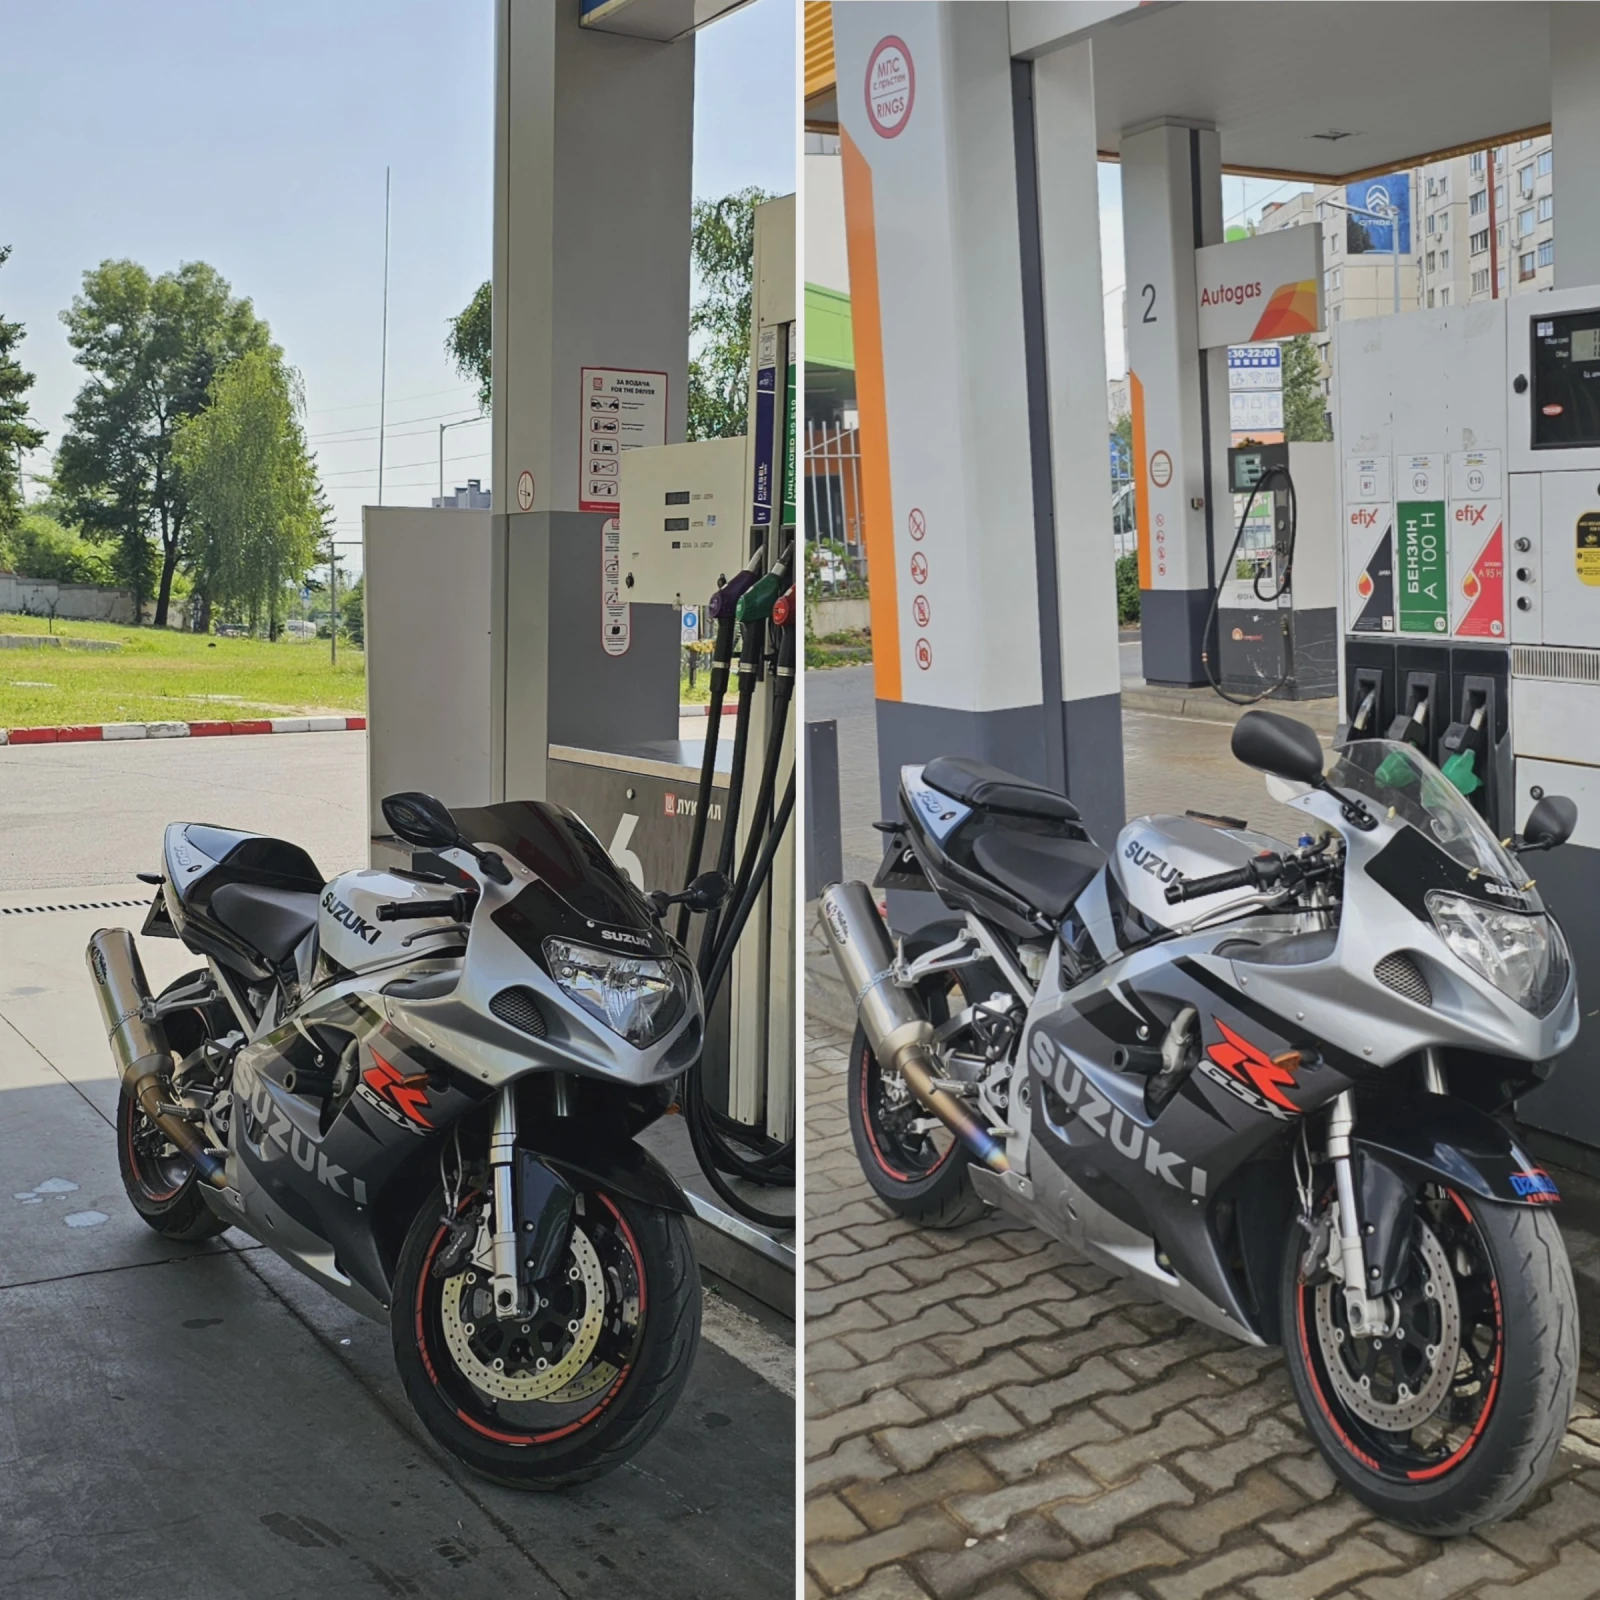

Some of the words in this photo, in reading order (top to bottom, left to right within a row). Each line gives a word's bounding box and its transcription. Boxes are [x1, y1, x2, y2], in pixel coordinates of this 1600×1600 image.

[877, 57, 900, 79] МПС
[877, 96, 905, 119] RINGS
[1142, 283, 1157, 323] 2
[1200, 281, 1262, 307] Autogas
[1228, 348, 1277, 358] :30-22:00
[625, 379, 650, 387] ВОДАЧА
[787, 438, 795, 500] UNLEADED
[1350, 508, 1378, 528] efix
[1455, 504, 1488, 526] efix
[1405, 519, 1420, 594] БЕНЗИН
[1421, 534, 1437, 573] 100
[1486, 568, 1496, 578] 95
[1124, 840, 1185, 888] SUZU
[321, 891, 383, 946] SUZUKI
[601, 930, 651, 948] SUZUKI
[356, 1083, 438, 1137] GSX
[1198, 1059, 1301, 1122] GSX
[232, 1059, 368, 1205] SUZUKI
[1028, 1029, 1208, 1198] SUZUKI
